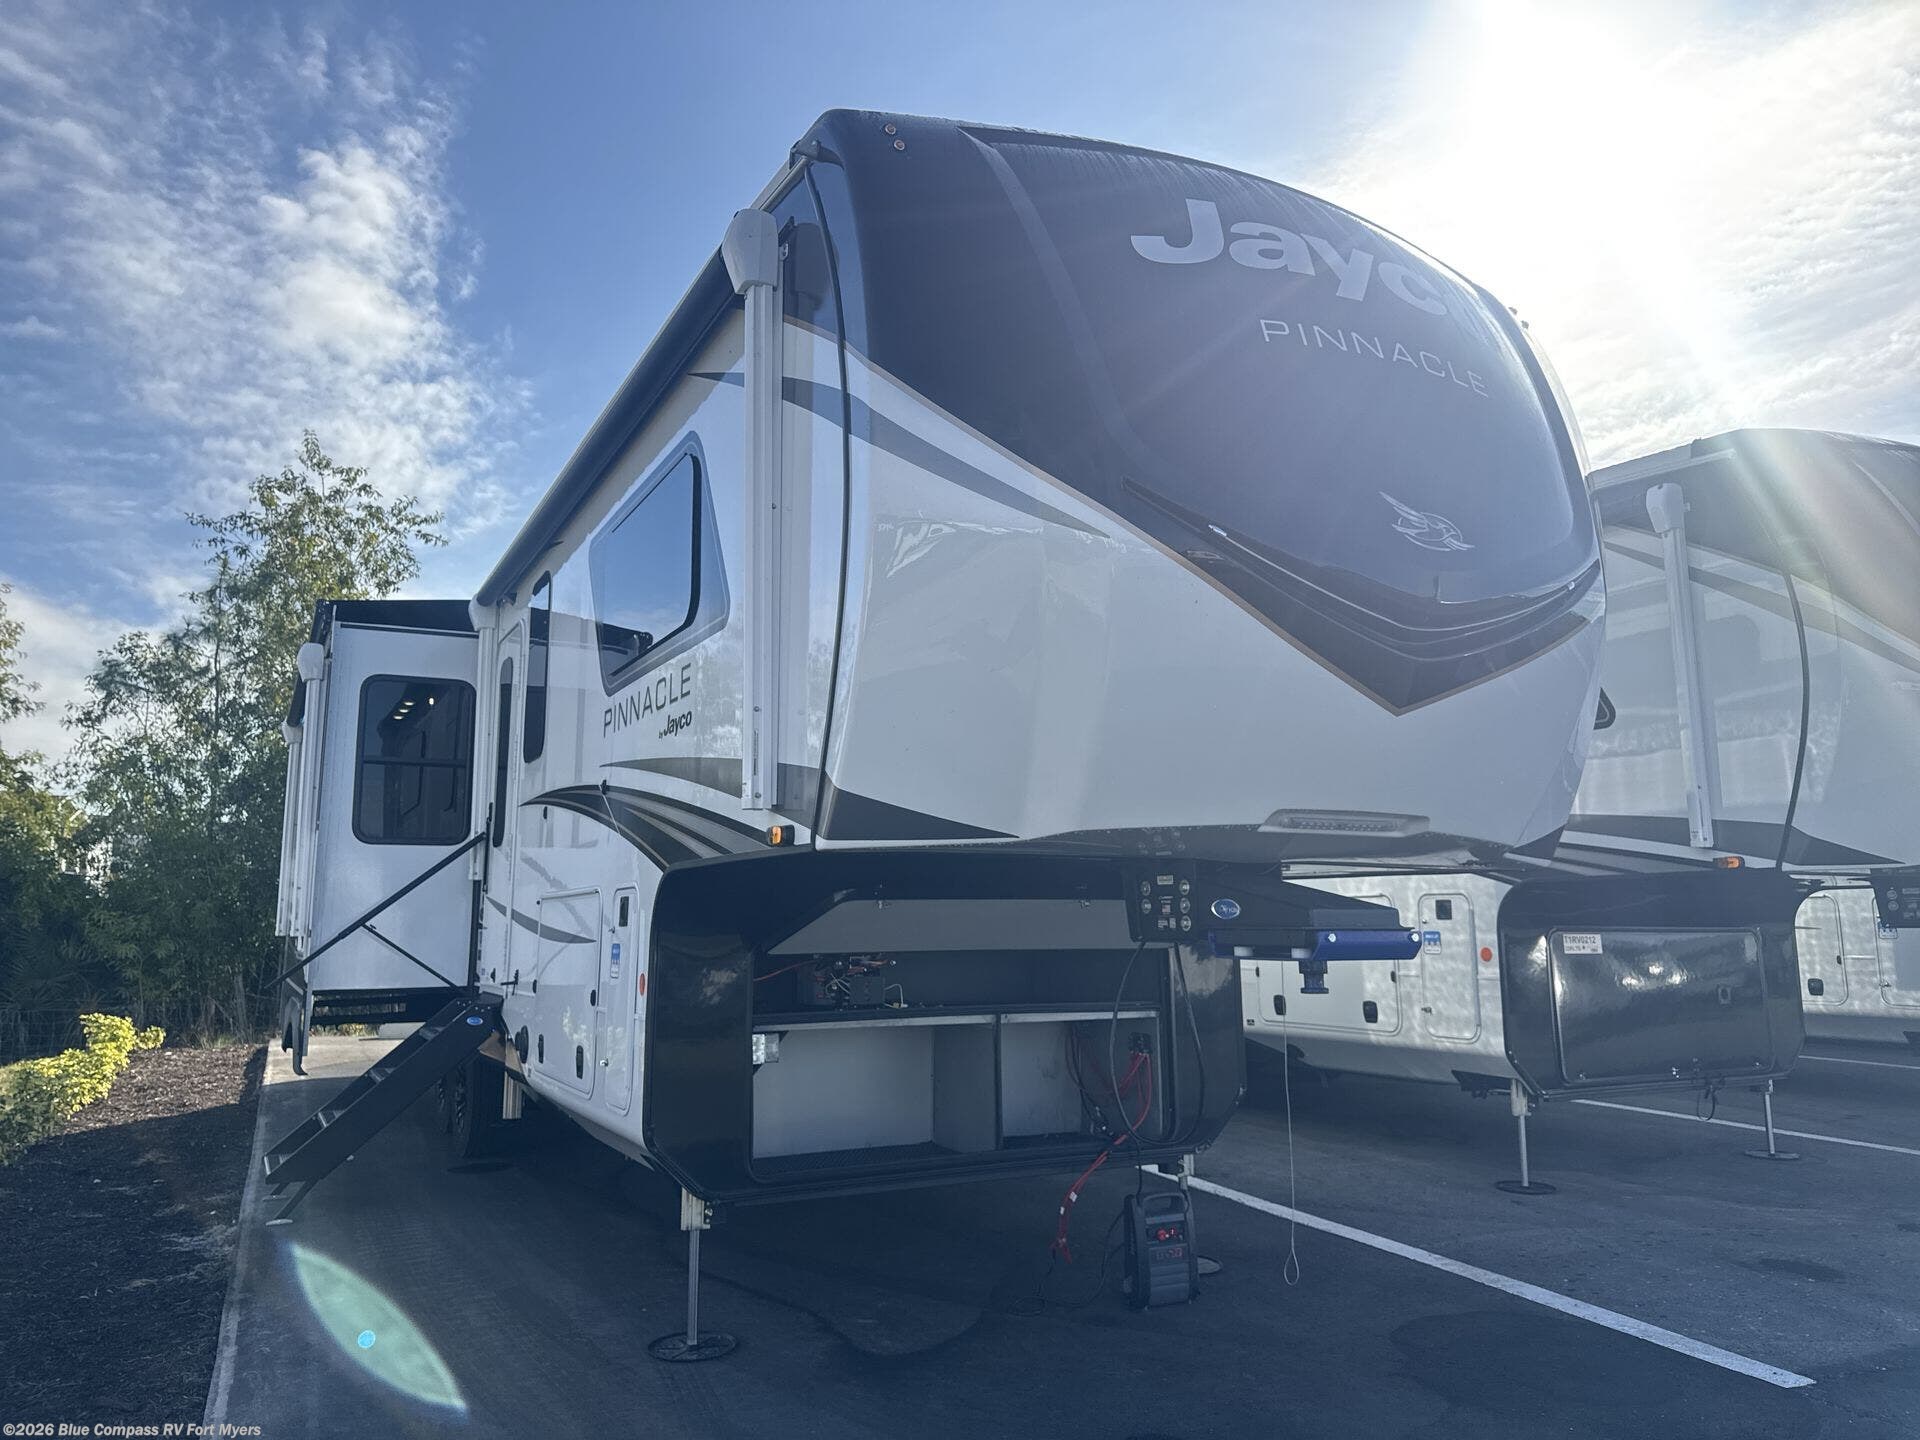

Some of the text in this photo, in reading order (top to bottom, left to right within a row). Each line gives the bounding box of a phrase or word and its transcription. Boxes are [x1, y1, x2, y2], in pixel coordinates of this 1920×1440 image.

[1259, 319, 1489, 398] PINNACLE
[603, 662, 692, 739] PINNACLE
[663, 711, 693, 737] Jayco
